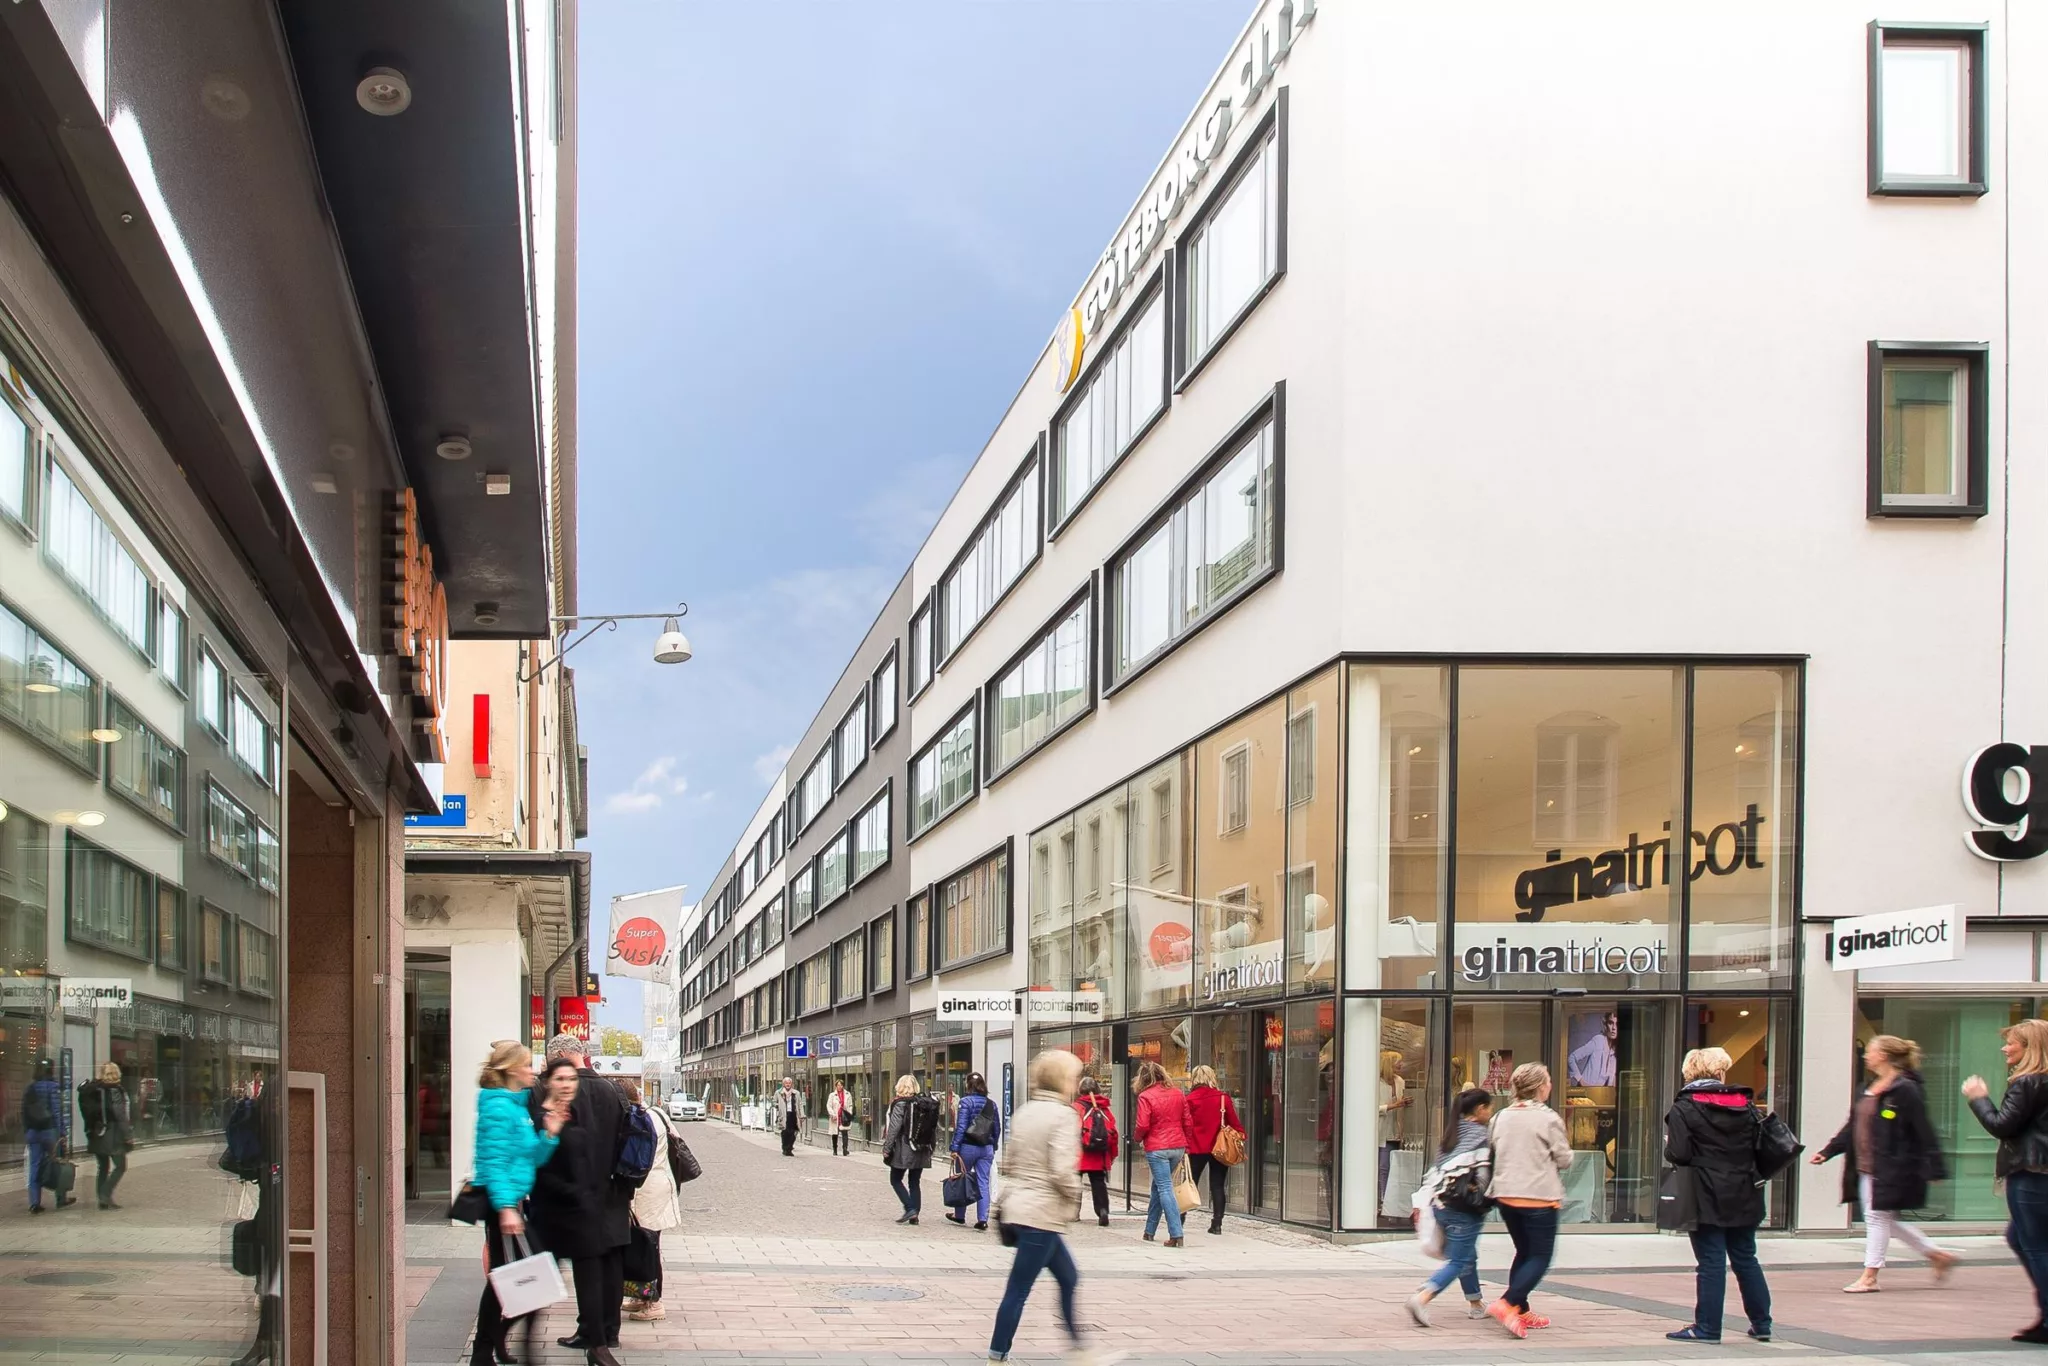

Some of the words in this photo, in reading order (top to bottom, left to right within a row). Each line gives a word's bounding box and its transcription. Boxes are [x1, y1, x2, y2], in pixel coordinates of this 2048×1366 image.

[1081, 82, 1231, 336] GÖTEBORG
[442, 799, 461, 810] tan
[404, 894, 451, 921] EX
[625, 926, 659, 940] Super
[1838, 919, 1948, 957] ginatricot
[608, 939, 672, 967] Sushi
[1462, 937, 1668, 983] ginatricot
[1202, 952, 1283, 1000] ginatricot
[942, 998, 1012, 1013] ginatricot
[560, 1022, 589, 1038] Sushi
[793, 1039, 804, 1055] P
